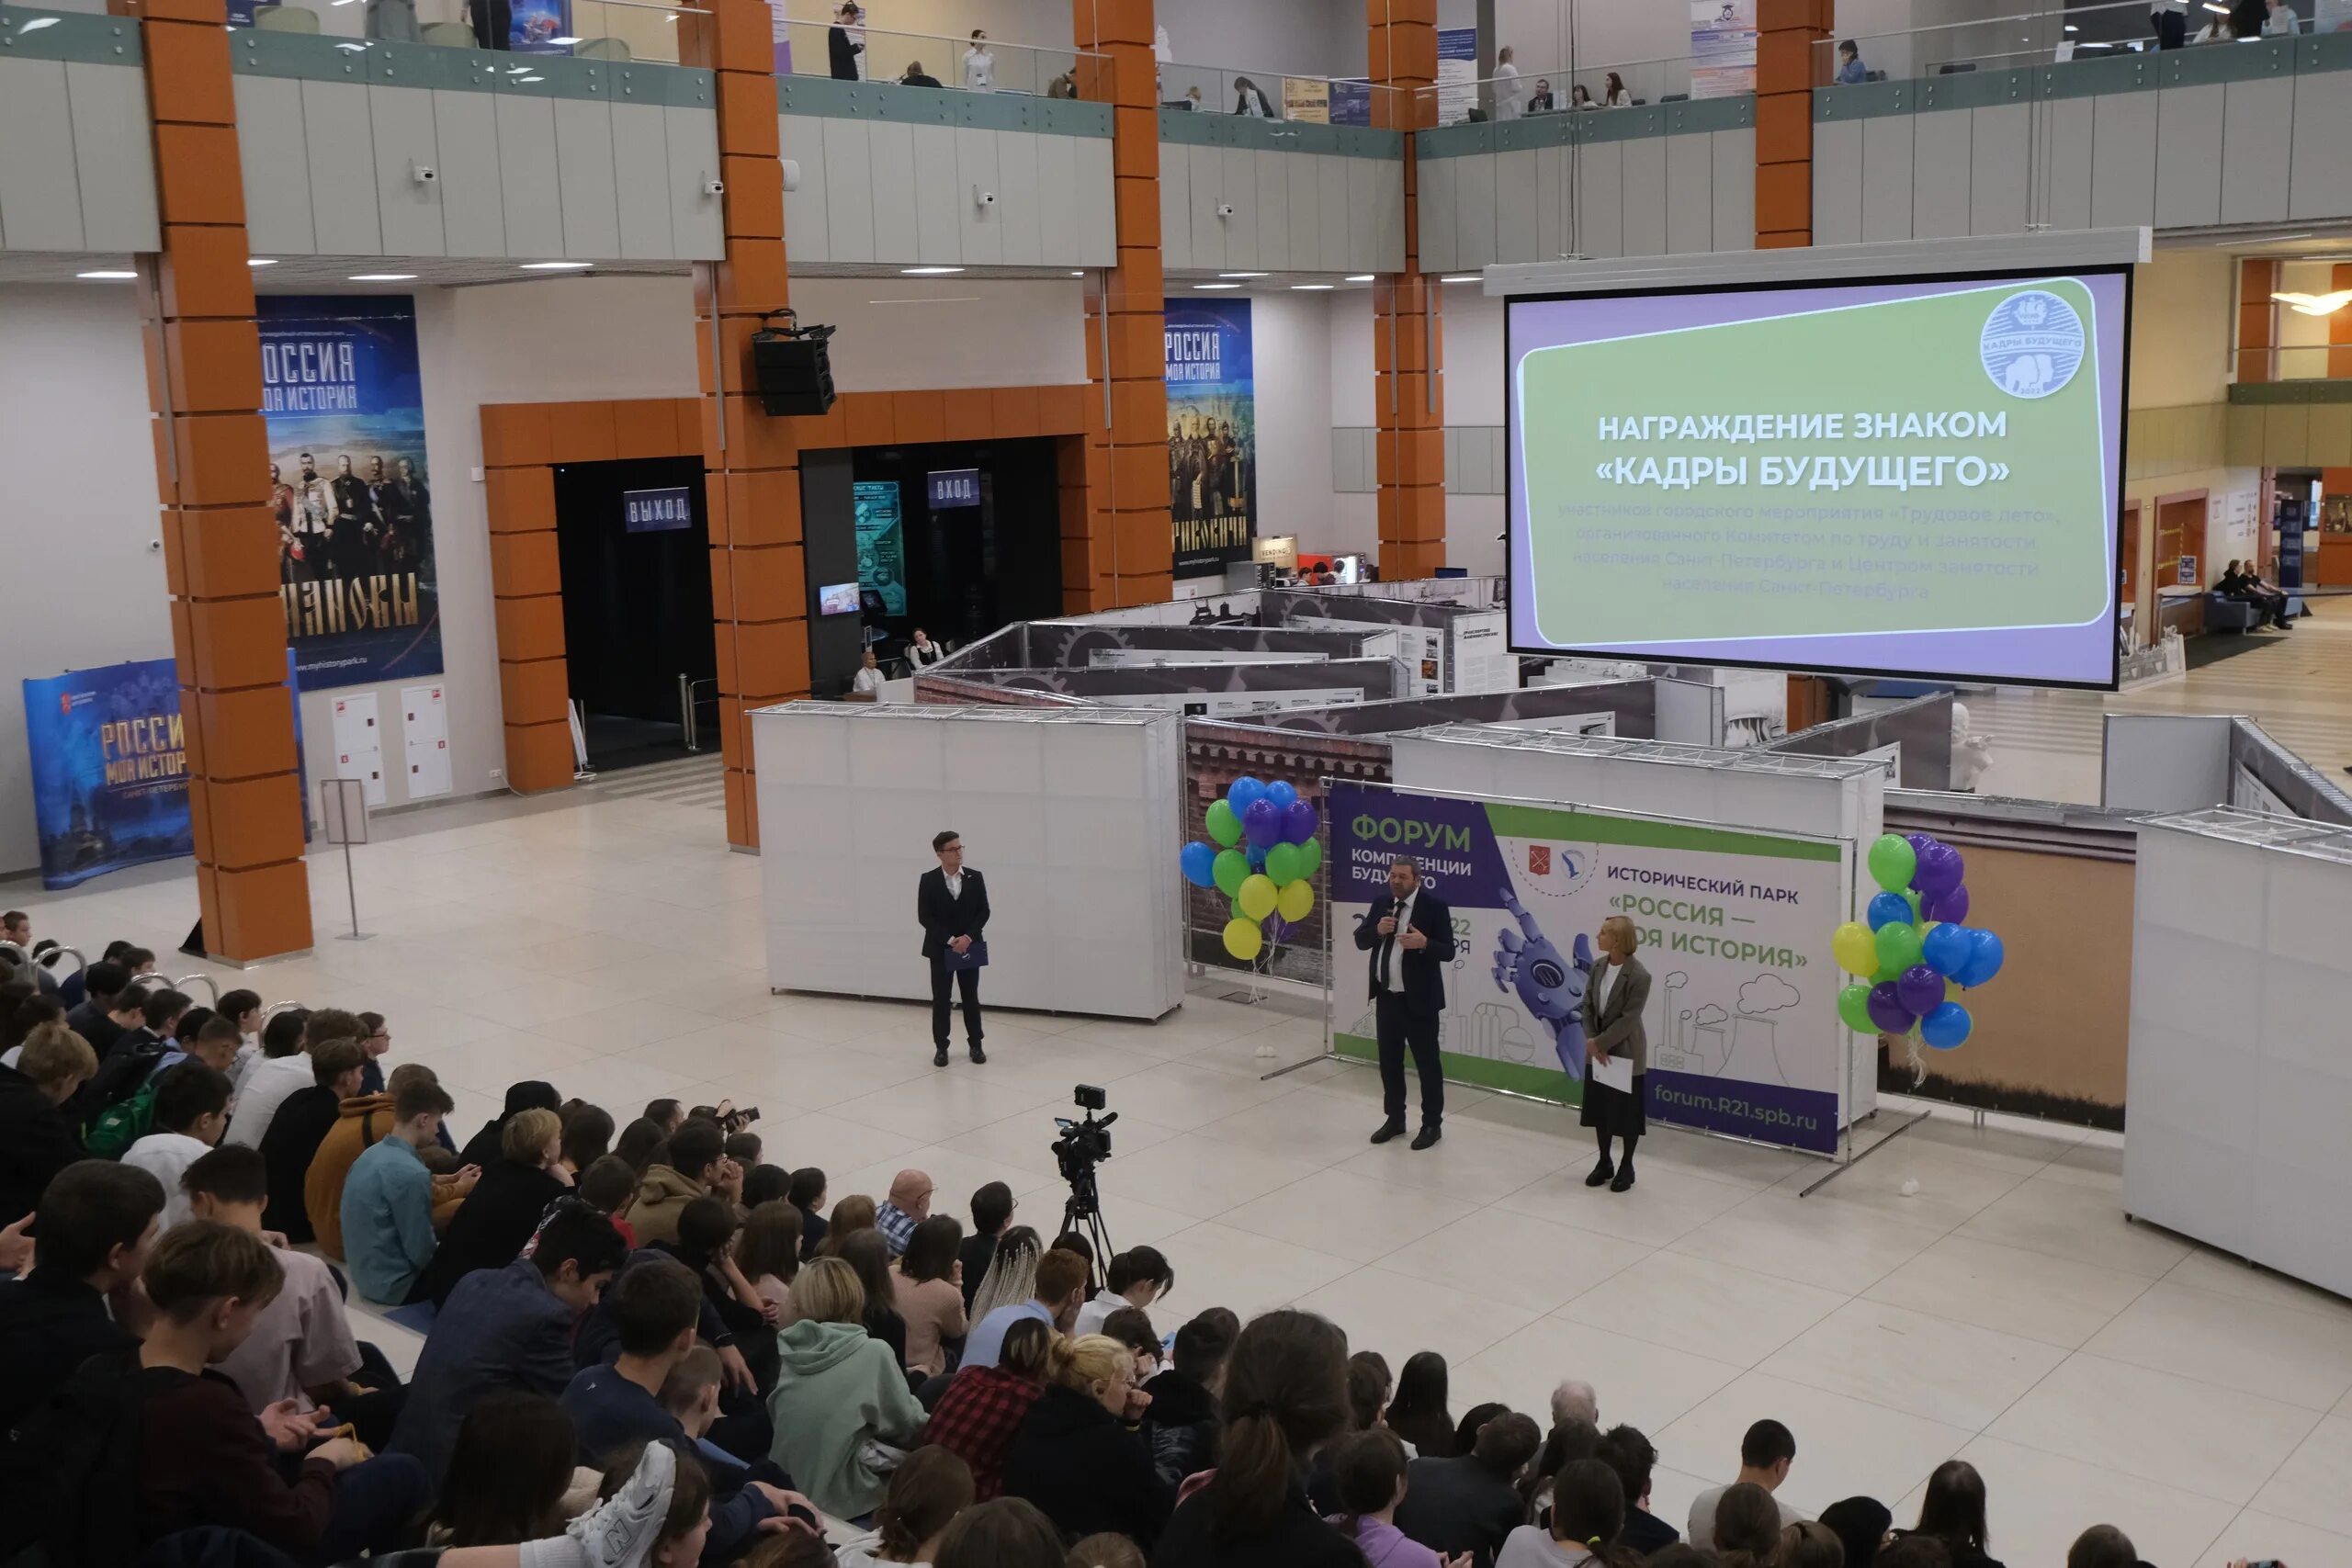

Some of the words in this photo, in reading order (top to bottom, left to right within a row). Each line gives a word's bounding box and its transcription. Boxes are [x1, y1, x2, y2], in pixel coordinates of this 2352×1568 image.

[1164, 332, 1220, 361] РОССИЯ
[1984, 338, 2022, 349] КАДРЫ
[2025, 336, 2082, 347] БУДУЩЕГО
[262, 342, 356, 383] ОССИЯ
[1166, 364, 1183, 381] МОЯ
[1185, 362, 1220, 380] ИСТОРИЯ
[263, 388, 284, 412] ОЯ
[287, 385, 357, 411] ИСТОРИЯ
[1598, 414, 1844, 444] НАГРАЖДЕНИЕ
[1853, 411, 2007, 439] ЗНАКОМ
[937, 479, 971, 500] ВХОД
[1596, 457, 1747, 491] «КАДРЫ
[1760, 457, 2010, 491] БУДУЩЕГО»
[629, 498, 686, 523] ВЫХОД
[1656, 506, 1754, 521] городского
[1759, 507, 1883, 523] мероприятия
[1171, 516, 1247, 553] РИКОВИЧИ
[1575, 527, 1722, 544] организованного
[1858, 535, 1912, 551] труду
[1936, 536, 2037, 551] занятости
[1939, 562, 2040, 577] занятости
[279, 572, 419, 637] МАНОВЫ
[101, 713, 185, 761] РОССИ
[105, 759, 136, 786] МОЯ
[138, 751, 187, 781] ИСТОР
[1351, 813, 1471, 852] ФОРУМ
[1351, 848, 1472, 876] КОМПЕНЦИИ
[1608, 865, 1744, 897] ИСТОРИЧЕСКИЙ
[1750, 886, 1799, 905] ПАРК
[1610, 894, 1724, 926] «РОССИЯ
[1634, 925, 1662, 949] ОЯ
[1671, 931, 1808, 967] ИСТОРИЯ»
[1654, 1084, 1817, 1131] forum.R21.spb.ru
